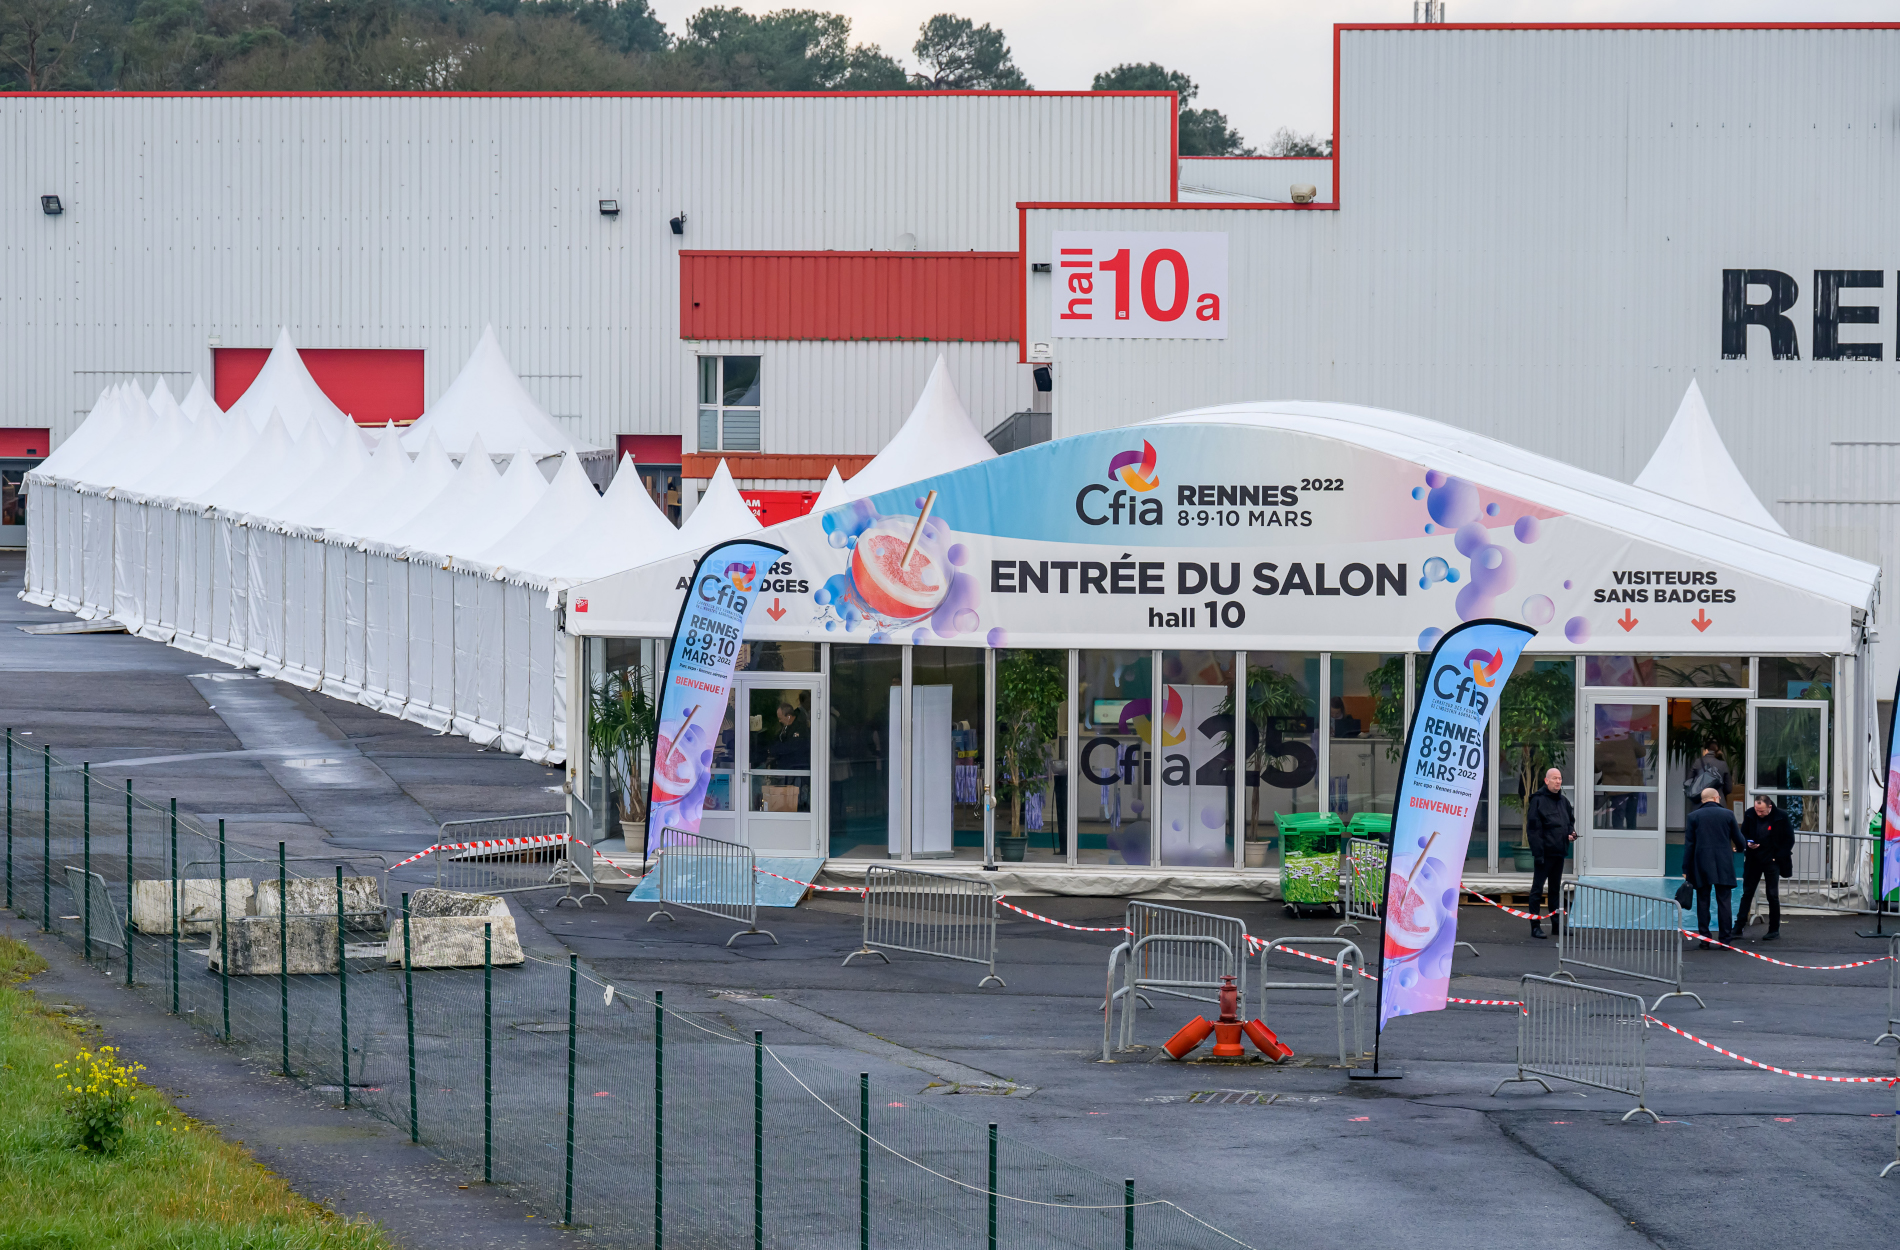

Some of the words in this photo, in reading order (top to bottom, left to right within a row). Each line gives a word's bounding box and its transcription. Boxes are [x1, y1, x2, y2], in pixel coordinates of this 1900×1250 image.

[1060, 248, 1093, 320] hall
[1721, 269, 1900, 362] RE
[1076, 483, 1163, 526] Cfia
[1177, 485, 1299, 507] RENNES
[1301, 478, 1344, 492] 2022
[1249, 510, 1313, 527] MARS
[990, 552, 1165, 595] ENTRÉE
[1177, 562, 1241, 595] DU
[1252, 562, 1408, 597] SALON
[1612, 571, 1718, 586] VISITEURS
[698, 574, 748, 615] Cfia
[1593, 589, 1649, 603] SANS
[1654, 589, 1737, 603] BADGES
[690, 614, 740, 640] RENNES
[1148, 607, 1196, 628] hall
[1204, 601, 1246, 628] 10
[681, 647, 716, 667] MARS
[717, 656, 732, 666] 2022
[675, 676, 720, 694] BIENVENUE
[1433, 664, 1489, 716] Cfia
[1424, 716, 1482, 748] RENNES
[1080, 737, 1190, 786] Cfia
[1415, 759, 1456, 782] MARS
[1457, 768, 1477, 781] 2022
[1409, 796, 1463, 817] BIENVENUE
